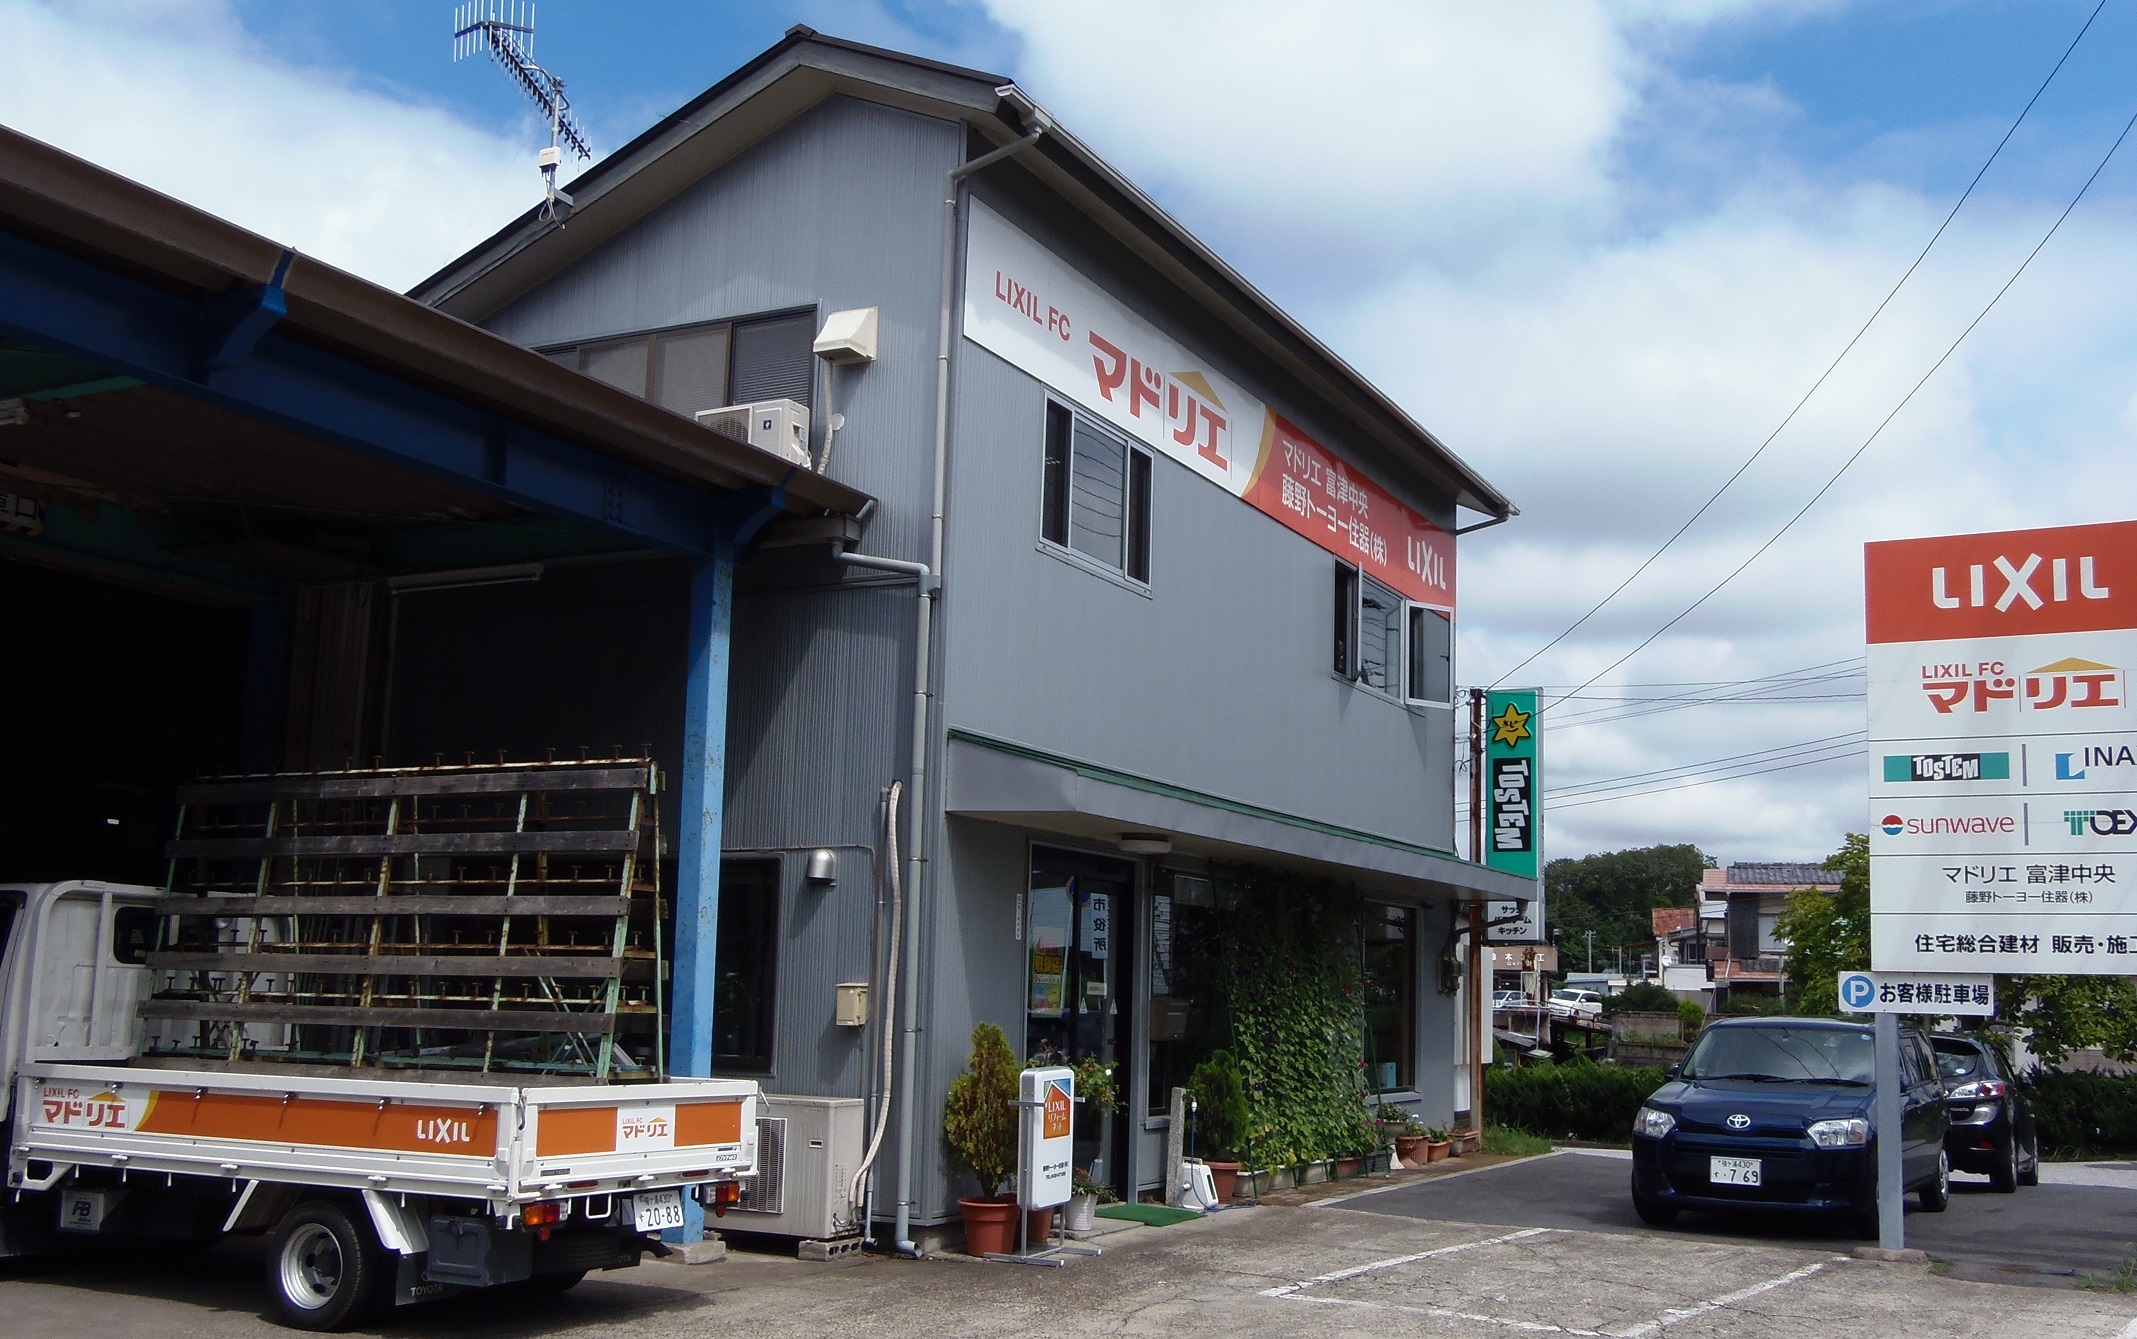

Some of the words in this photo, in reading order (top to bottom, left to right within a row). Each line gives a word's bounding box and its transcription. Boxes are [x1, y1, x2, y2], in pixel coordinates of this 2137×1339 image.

[994, 269, 1044, 326] LIXIL
[1048, 305, 1072, 342] FC
[1088, 330, 1229, 473] マドリエ
[1281, 439, 1322, 487] マドリエ
[1325, 467, 1369, 519] 富津中央
[1406, 534, 1447, 591] LIXIL
[1931, 552, 2109, 613] LIXIL
[1921, 663, 1973, 679] LIXIL
[1978, 660, 2005, 677] FC
[1922, 674, 2119, 713] マドリエ
[1912, 753, 1980, 781] TOSTEM
[2084, 745, 2137, 767] INA
[1493, 759, 1529, 850] TOSTEM
[1906, 813, 2015, 836] sunwave
[1942, 865, 2018, 885] マドリエ
[2026, 863, 2116, 885] 富津中央
[1964, 890, 2094, 905] 藤野トーヨー住器(株)
[1498, 926, 1527, 935] キッチン
[1914, 934, 2040, 955] 住宅総合建材
[1878, 982, 1990, 1007] お客様駐車場
[43, 1087, 66, 1098] LIXIL
[68, 1088, 80, 1099] FC
[43, 1100, 126, 1127] マドリエ
[1048, 1100, 1066, 1113] LIXIL
[417, 1118, 470, 1143] LIXIL
[622, 1123, 668, 1139] マドリエ
[410, 1283, 444, 1297] TOYOTA
